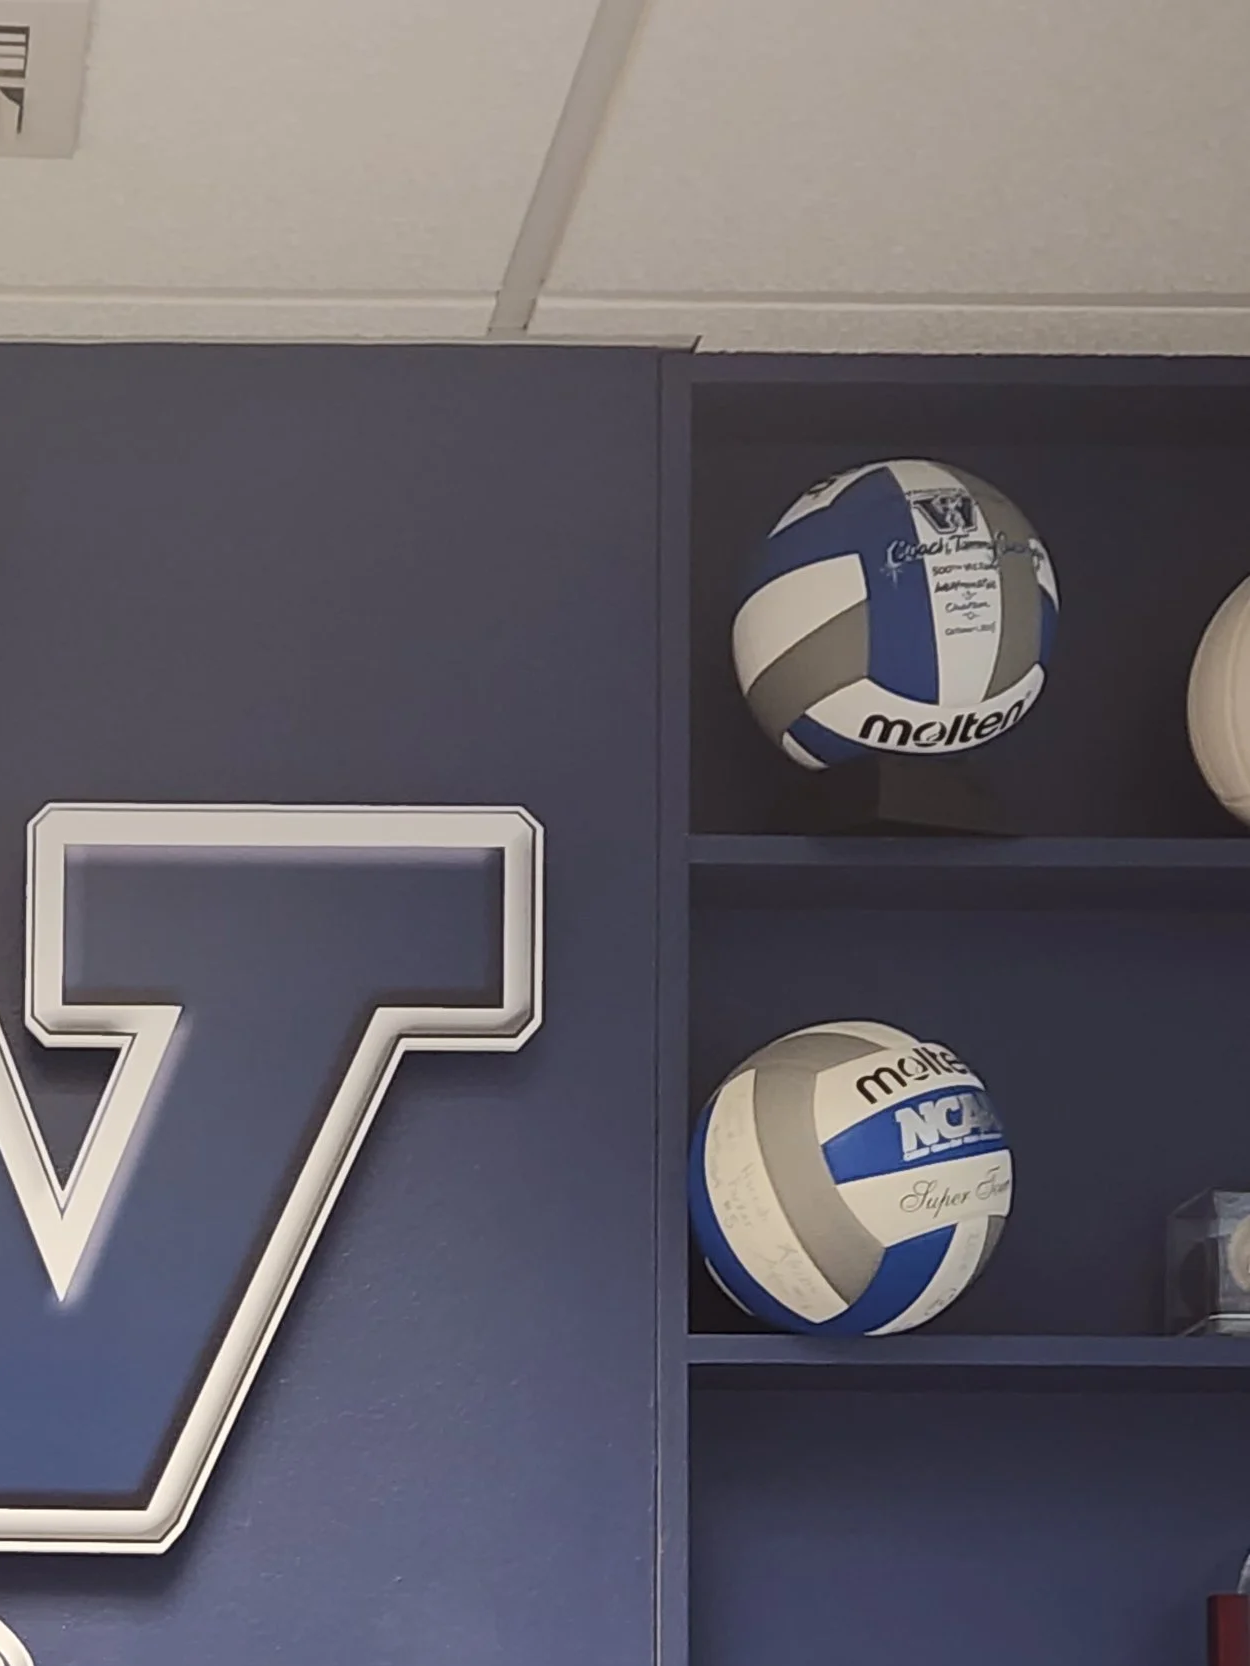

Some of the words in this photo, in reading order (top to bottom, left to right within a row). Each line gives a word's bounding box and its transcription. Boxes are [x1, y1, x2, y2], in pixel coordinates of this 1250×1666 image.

[859, 699, 1025, 747] molten
[856, 1046, 969, 1105] molte
[900, 1180, 971, 1218] Super
